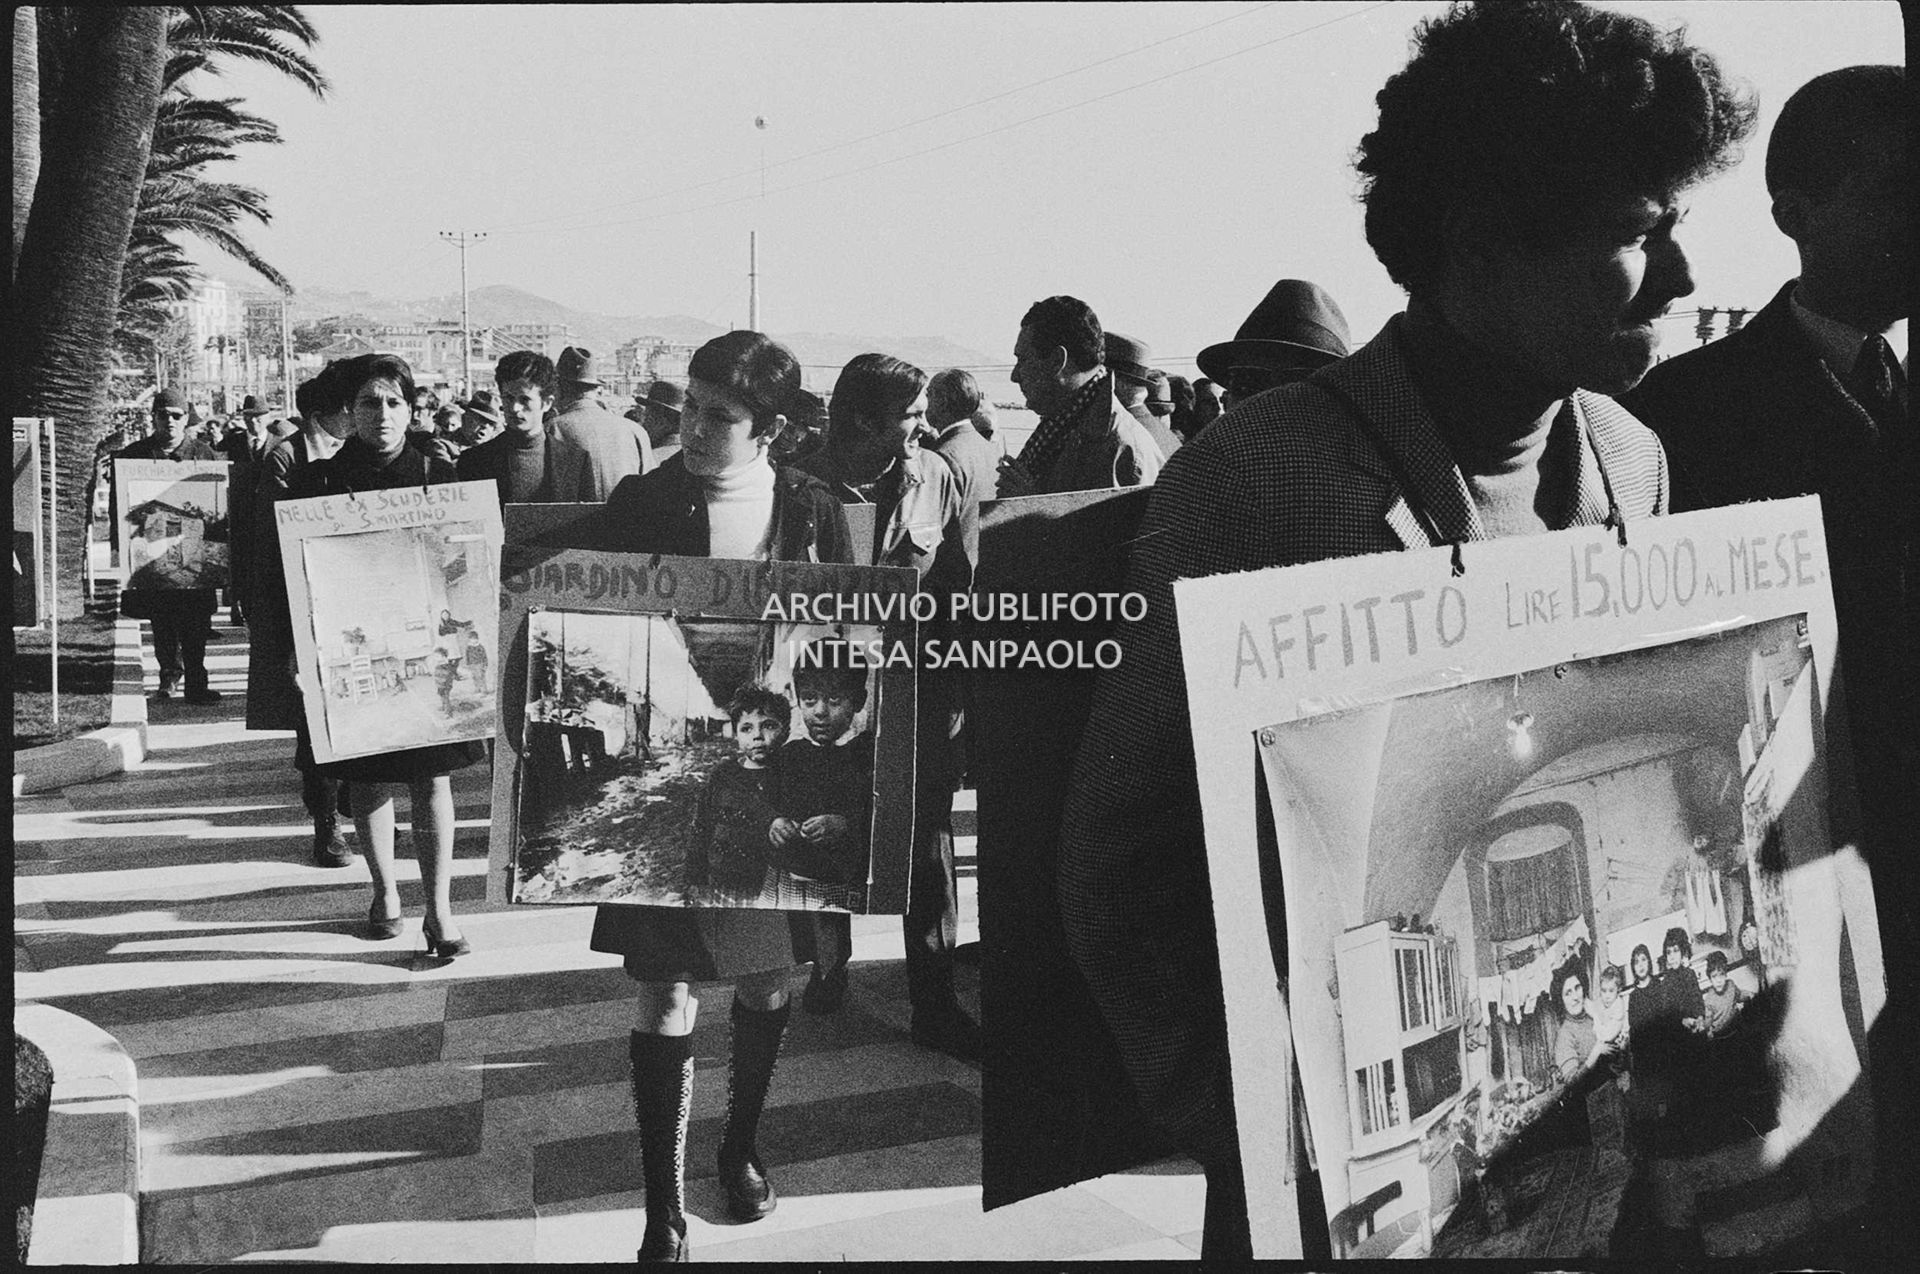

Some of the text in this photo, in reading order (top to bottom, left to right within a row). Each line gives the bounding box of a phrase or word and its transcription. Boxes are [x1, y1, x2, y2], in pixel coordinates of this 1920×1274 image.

[376, 486, 469, 511] SCUDERIE
[1233, 585, 1467, 688] AFFITTO
[1505, 581, 1562, 630] LIRE
